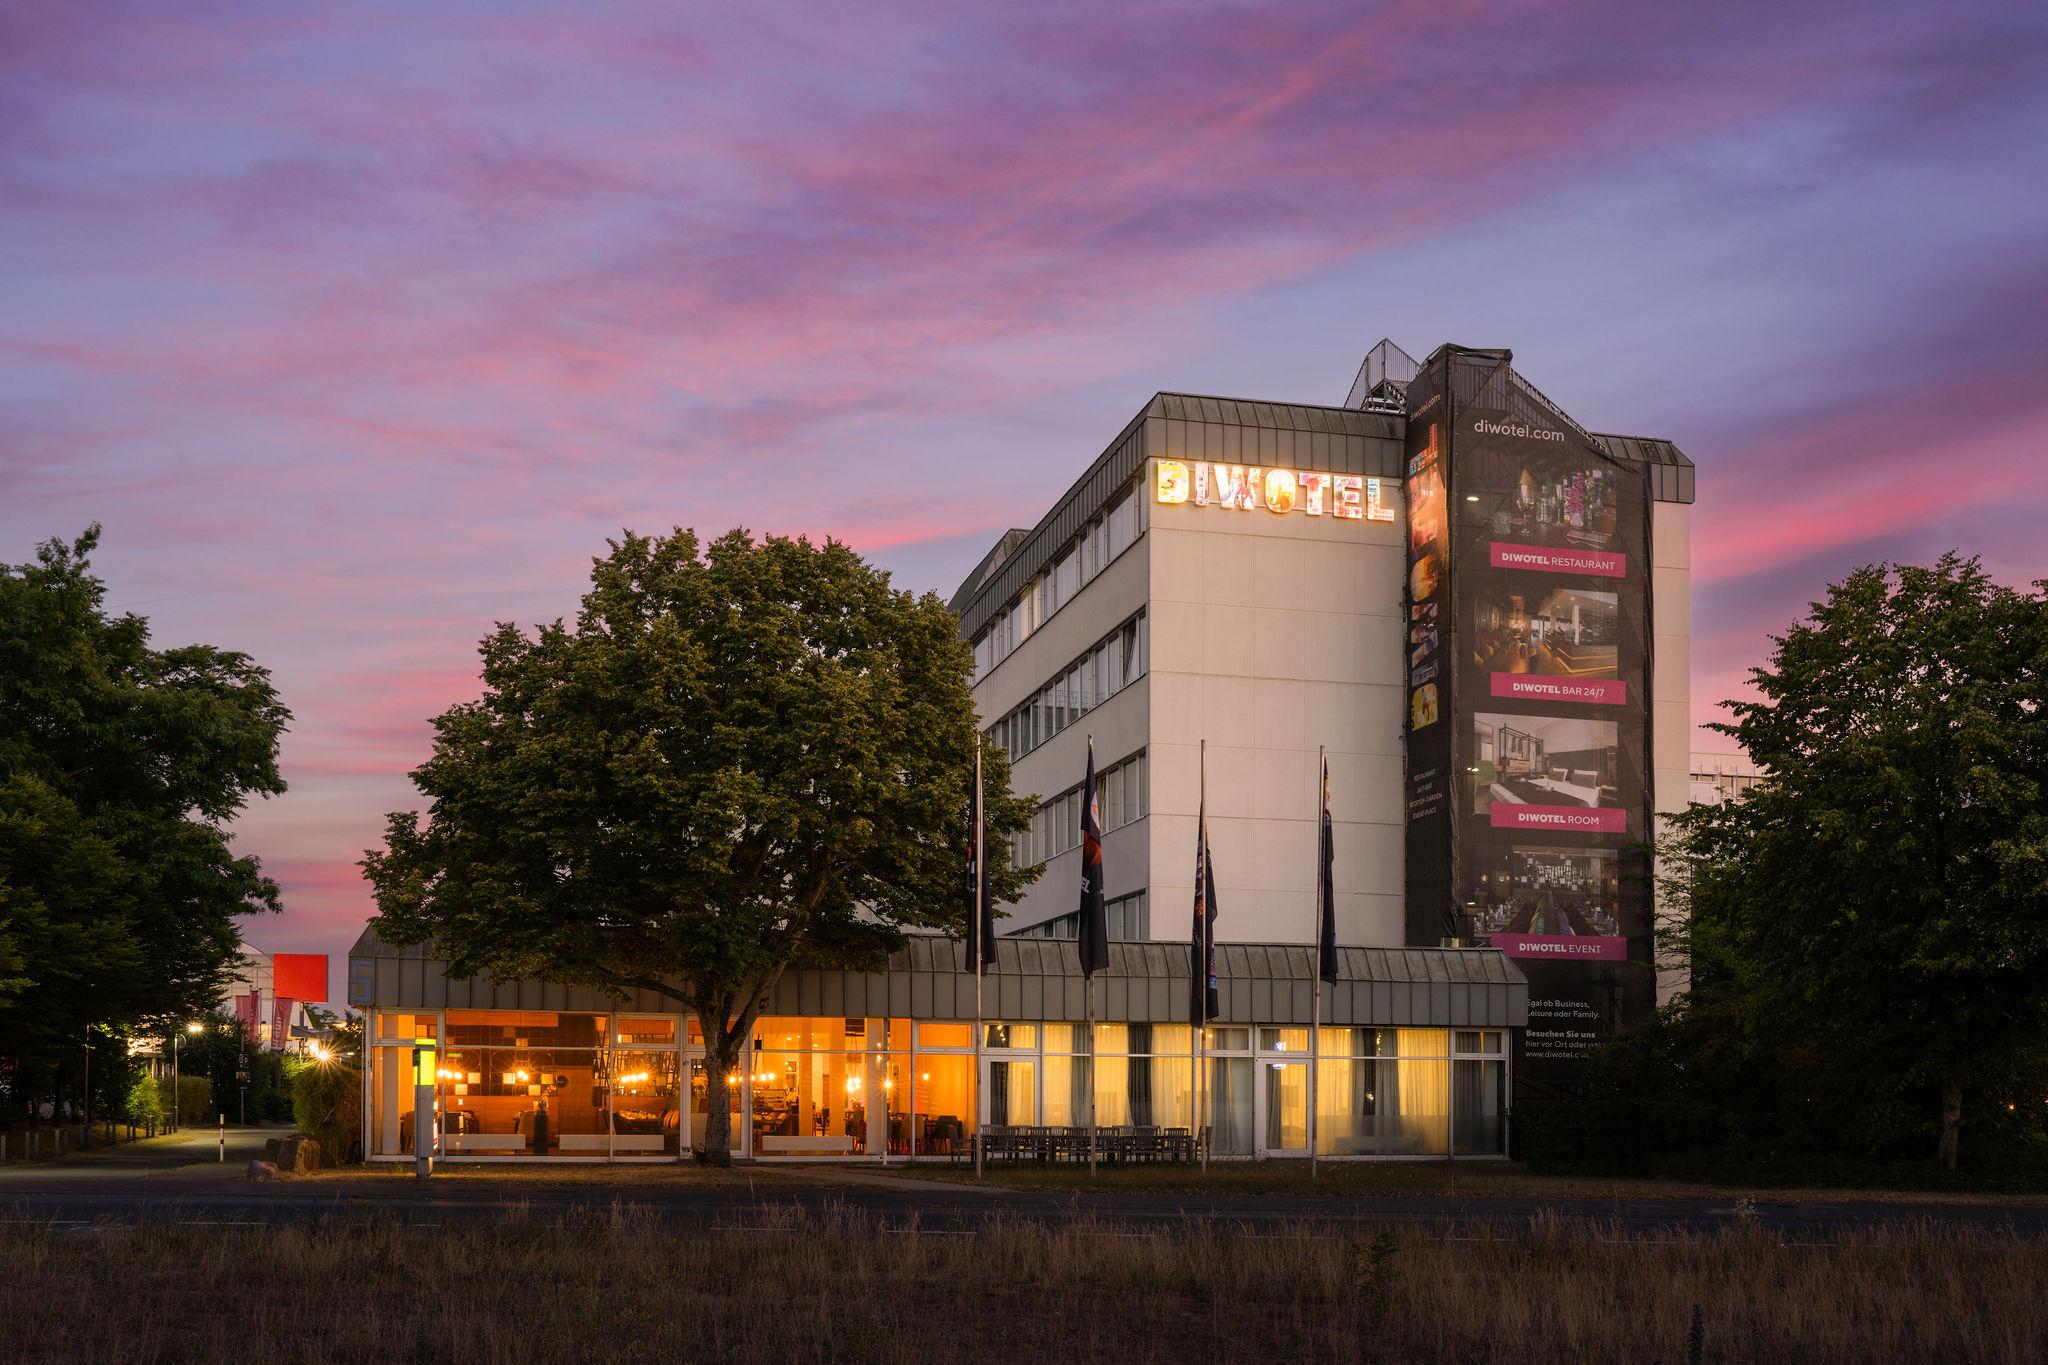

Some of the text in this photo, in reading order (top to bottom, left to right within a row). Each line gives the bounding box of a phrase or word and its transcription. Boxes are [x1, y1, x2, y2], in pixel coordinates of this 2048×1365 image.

[1474, 420, 1564, 442] diwotel.com
[1157, 460, 1394, 521] DIWOTEL
[1502, 552, 1615, 570] DIWOTEL RESTAURANT
[1513, 682, 1605, 698] DIWOTEL BAR 24/7
[1518, 813, 1599, 825] DIWOTEL ROOM
[1519, 943, 1601, 954] DIWOTEL EVENT
[1543, 999, 1554, 1007] ob
[1555, 999, 1591, 1009] Business,
[1553, 1010, 1572, 1018] oder
[1573, 1010, 1600, 1020] Family.
[1525, 1029, 1596, 1039] Besuchen Sie uns
[1525, 1040, 1540, 1048] hier
[1554, 1040, 1568, 1048] Ort
[1568, 1041, 1586, 1049] oder
[1525, 1051, 1590, 1059] www.diwotel.cm
